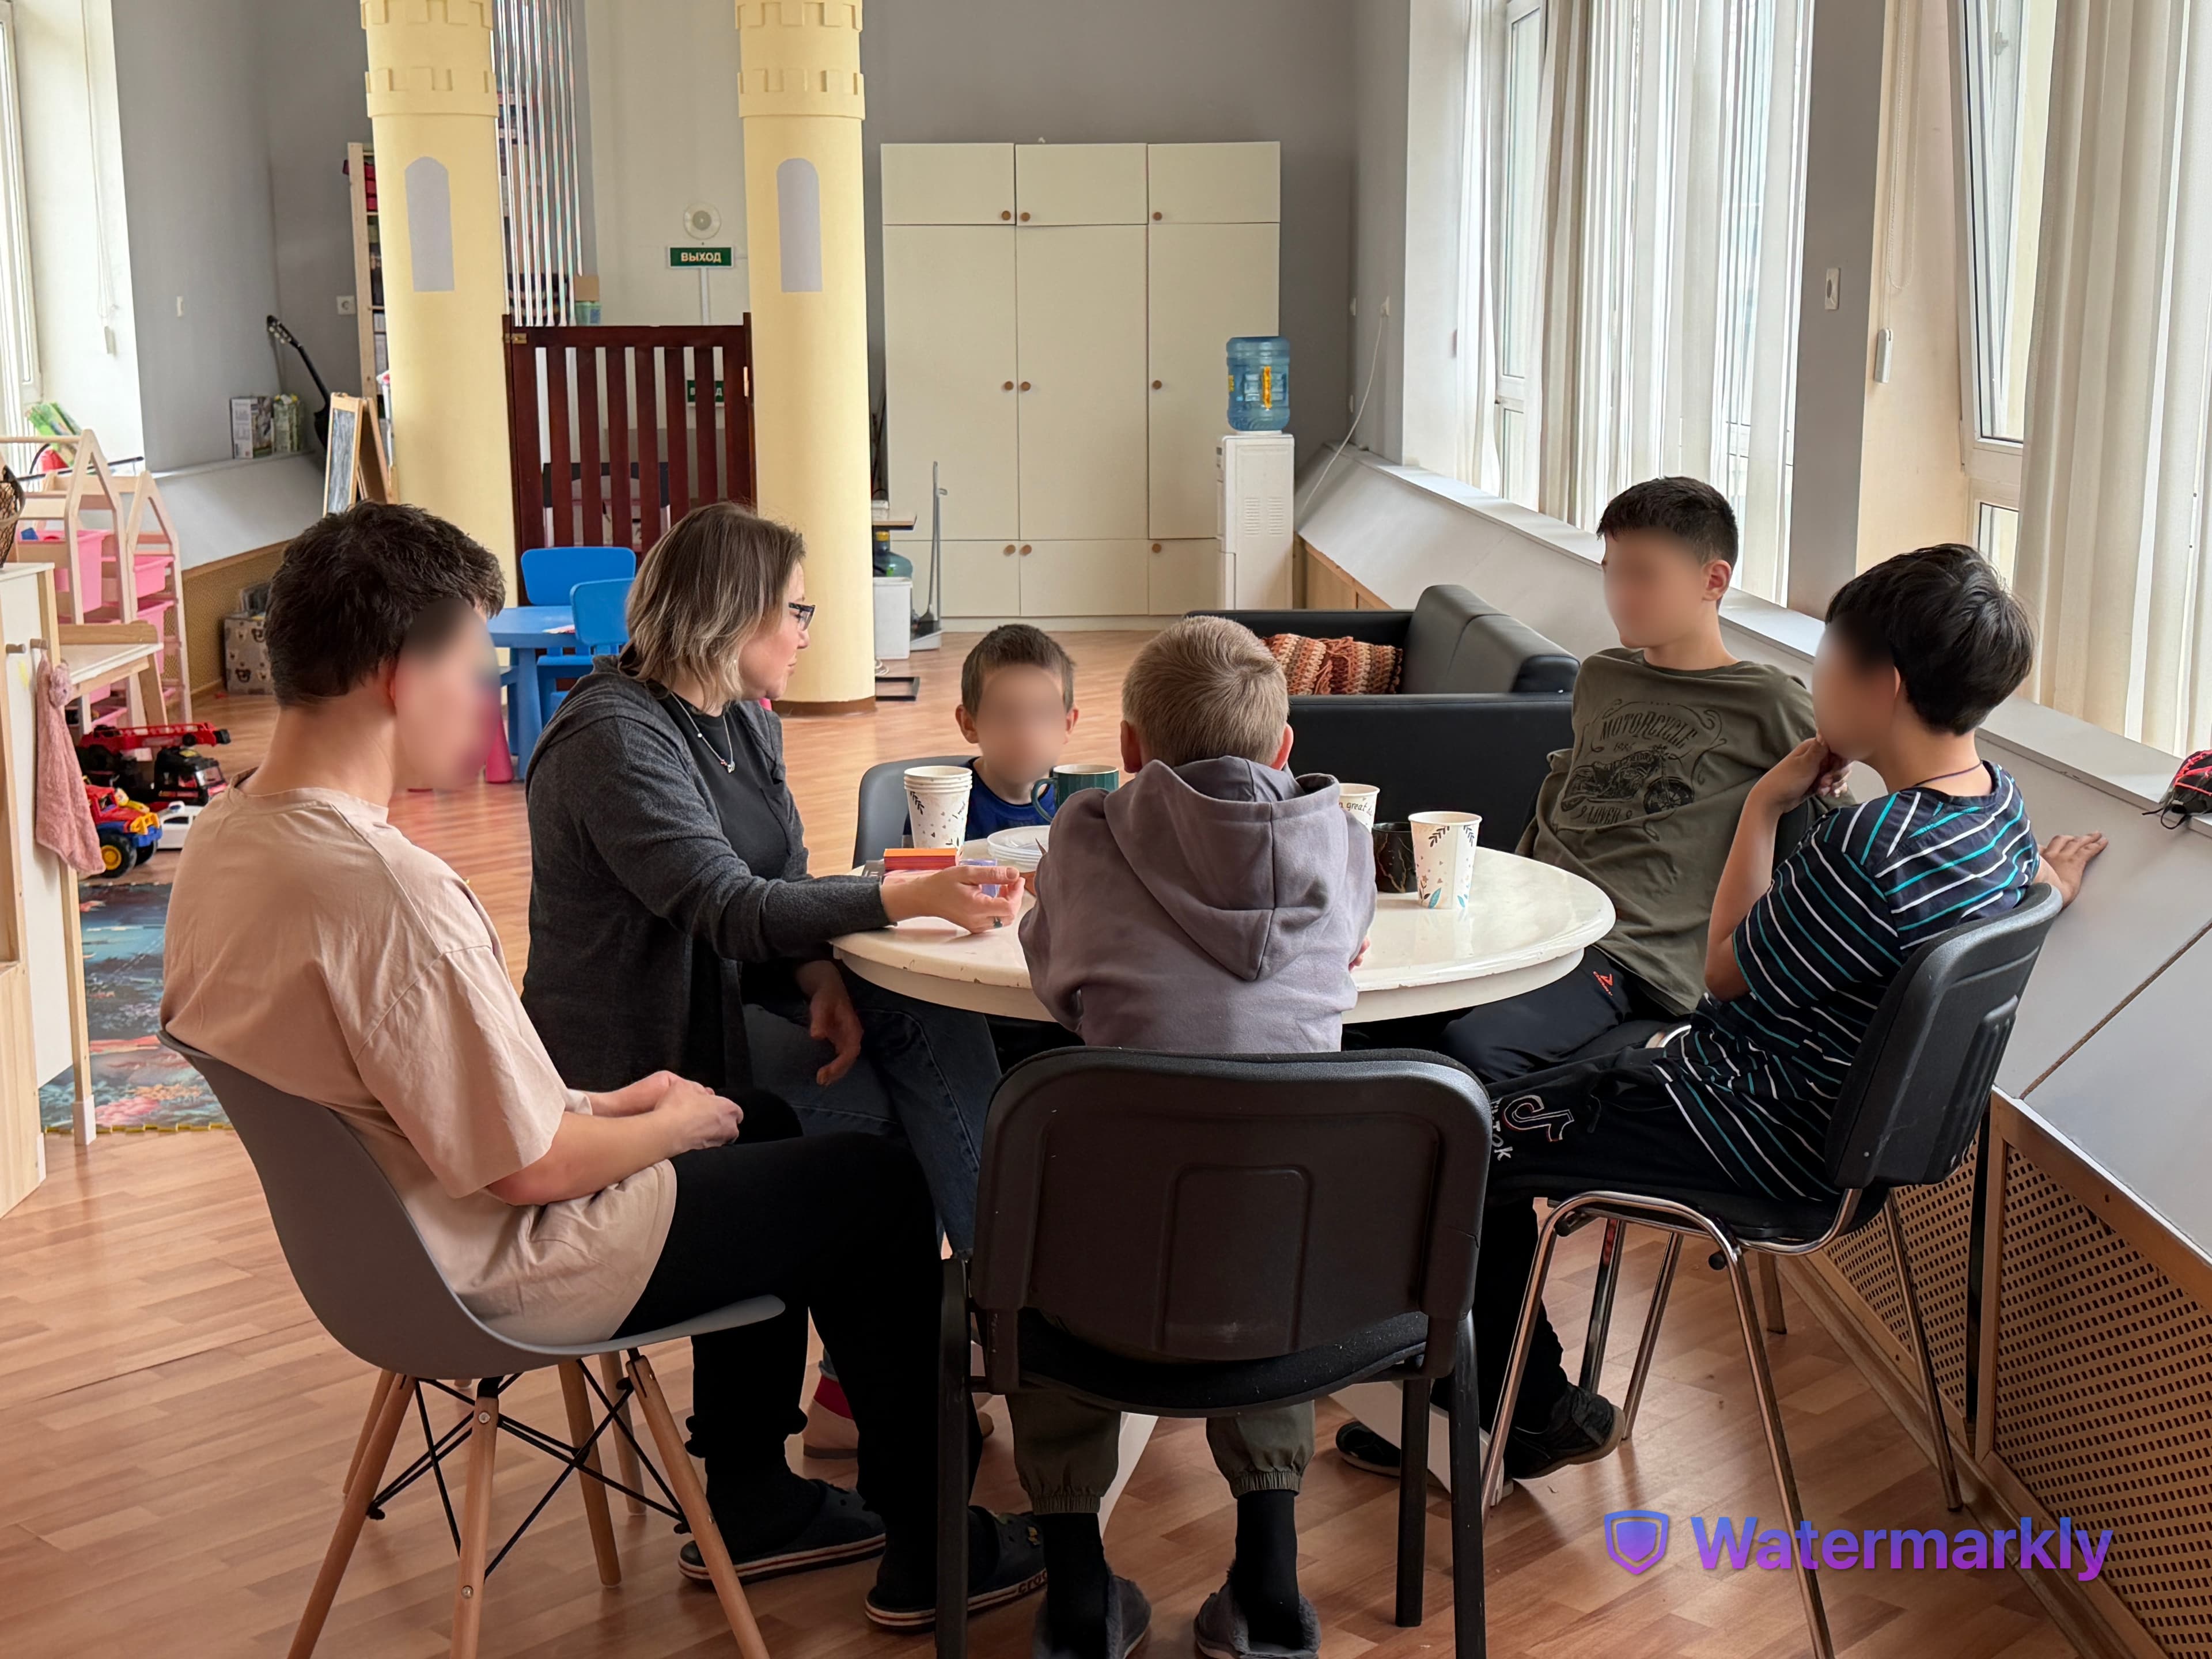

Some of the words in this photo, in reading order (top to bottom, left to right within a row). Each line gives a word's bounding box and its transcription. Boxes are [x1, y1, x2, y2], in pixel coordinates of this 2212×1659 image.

[681, 252, 721, 263] ВЫХОД
[1600, 711, 1698, 749] MOTORCYCLE
[1346, 802, 1368, 812] great
[1586, 806, 1622, 825] LOVER
